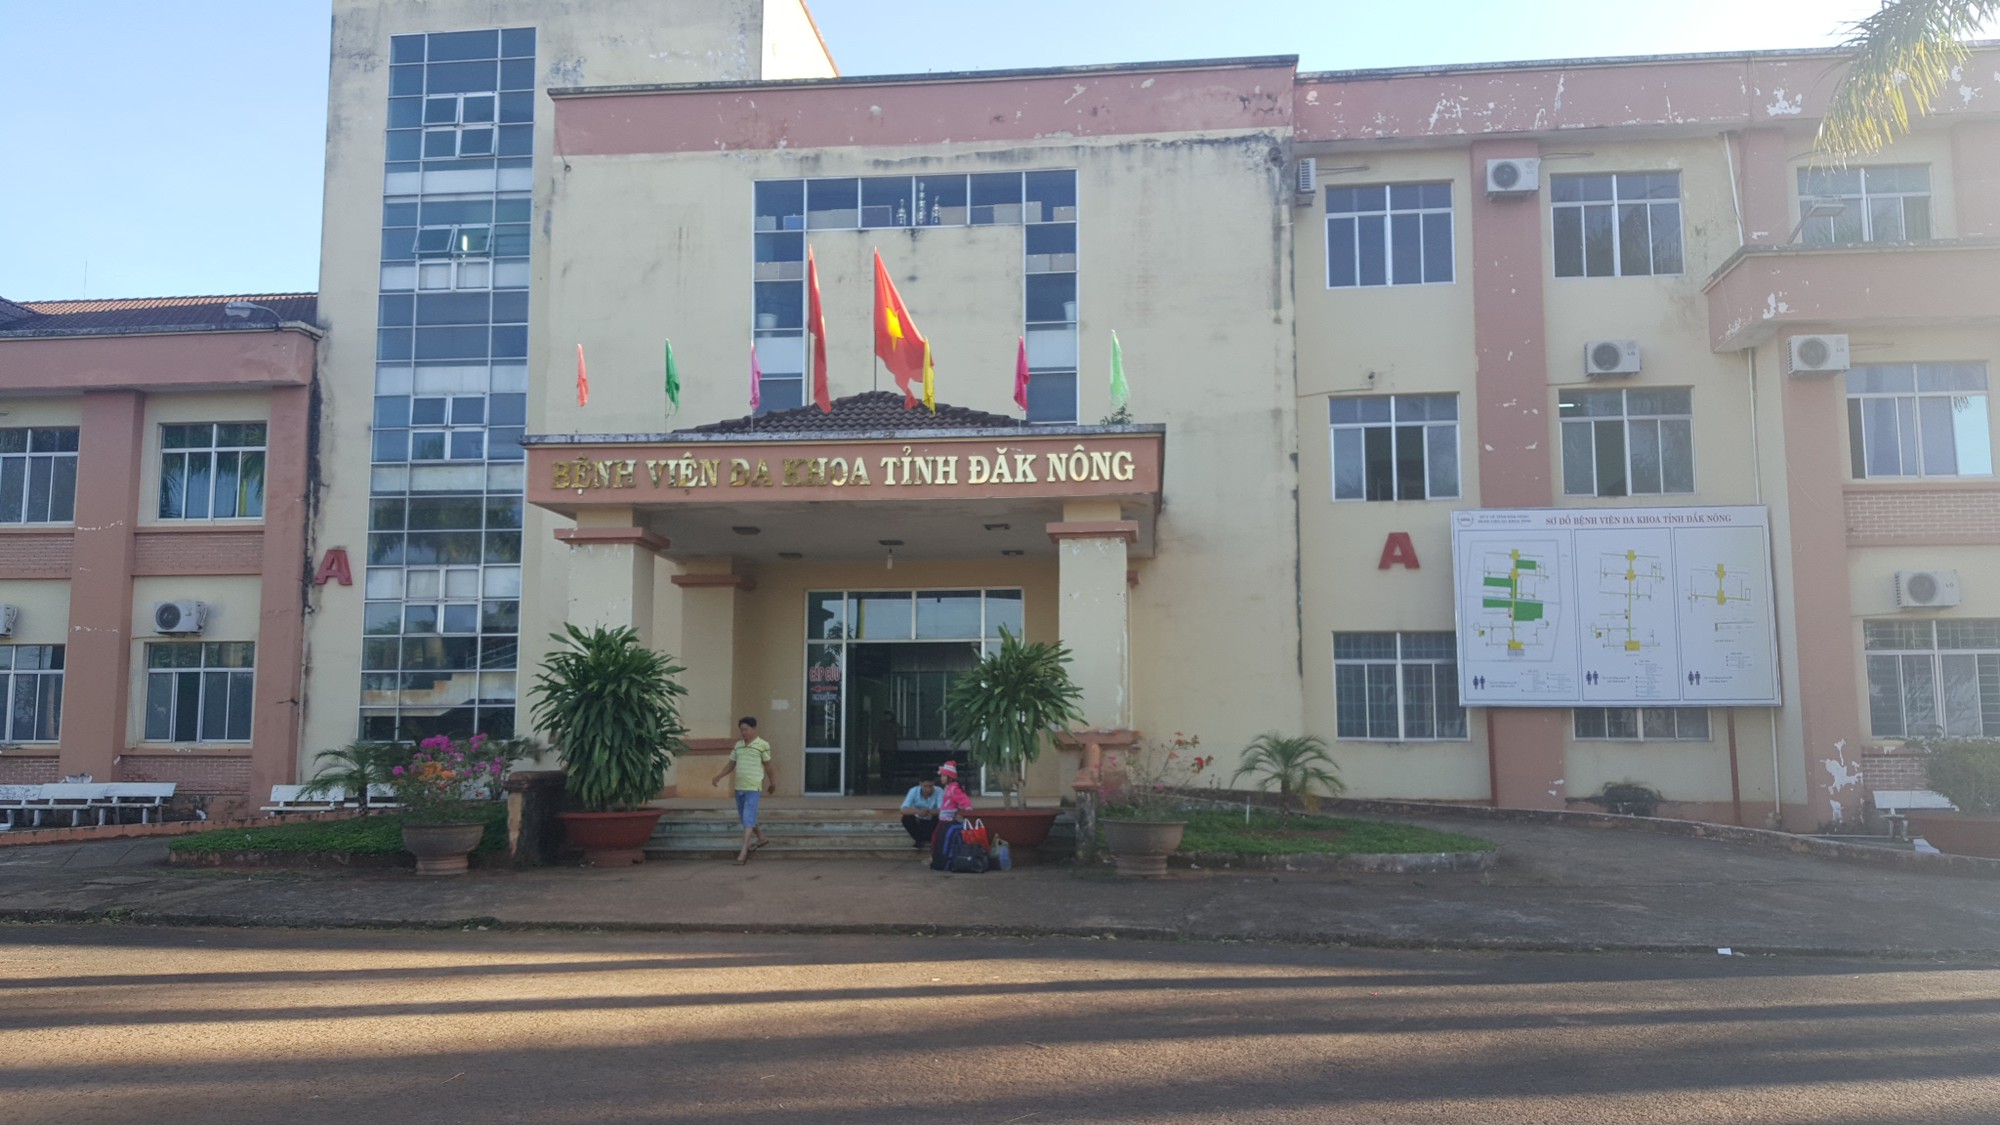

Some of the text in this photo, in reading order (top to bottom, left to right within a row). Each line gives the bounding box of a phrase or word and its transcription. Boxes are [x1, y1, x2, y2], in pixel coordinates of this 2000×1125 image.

[552, 444, 1136, 496] BỆNH VIỆN ĐA KHOA TỈNH ĐĂK NÔNG
[1573, 514, 1597, 528] BỆNH
[1599, 514, 1621, 527] VIỆN
[1637, 515, 1661, 525] KHOA
[1707, 512, 1732, 523] NÔNG
[315, 549, 353, 586] A
[1377, 532, 1420, 570] A
